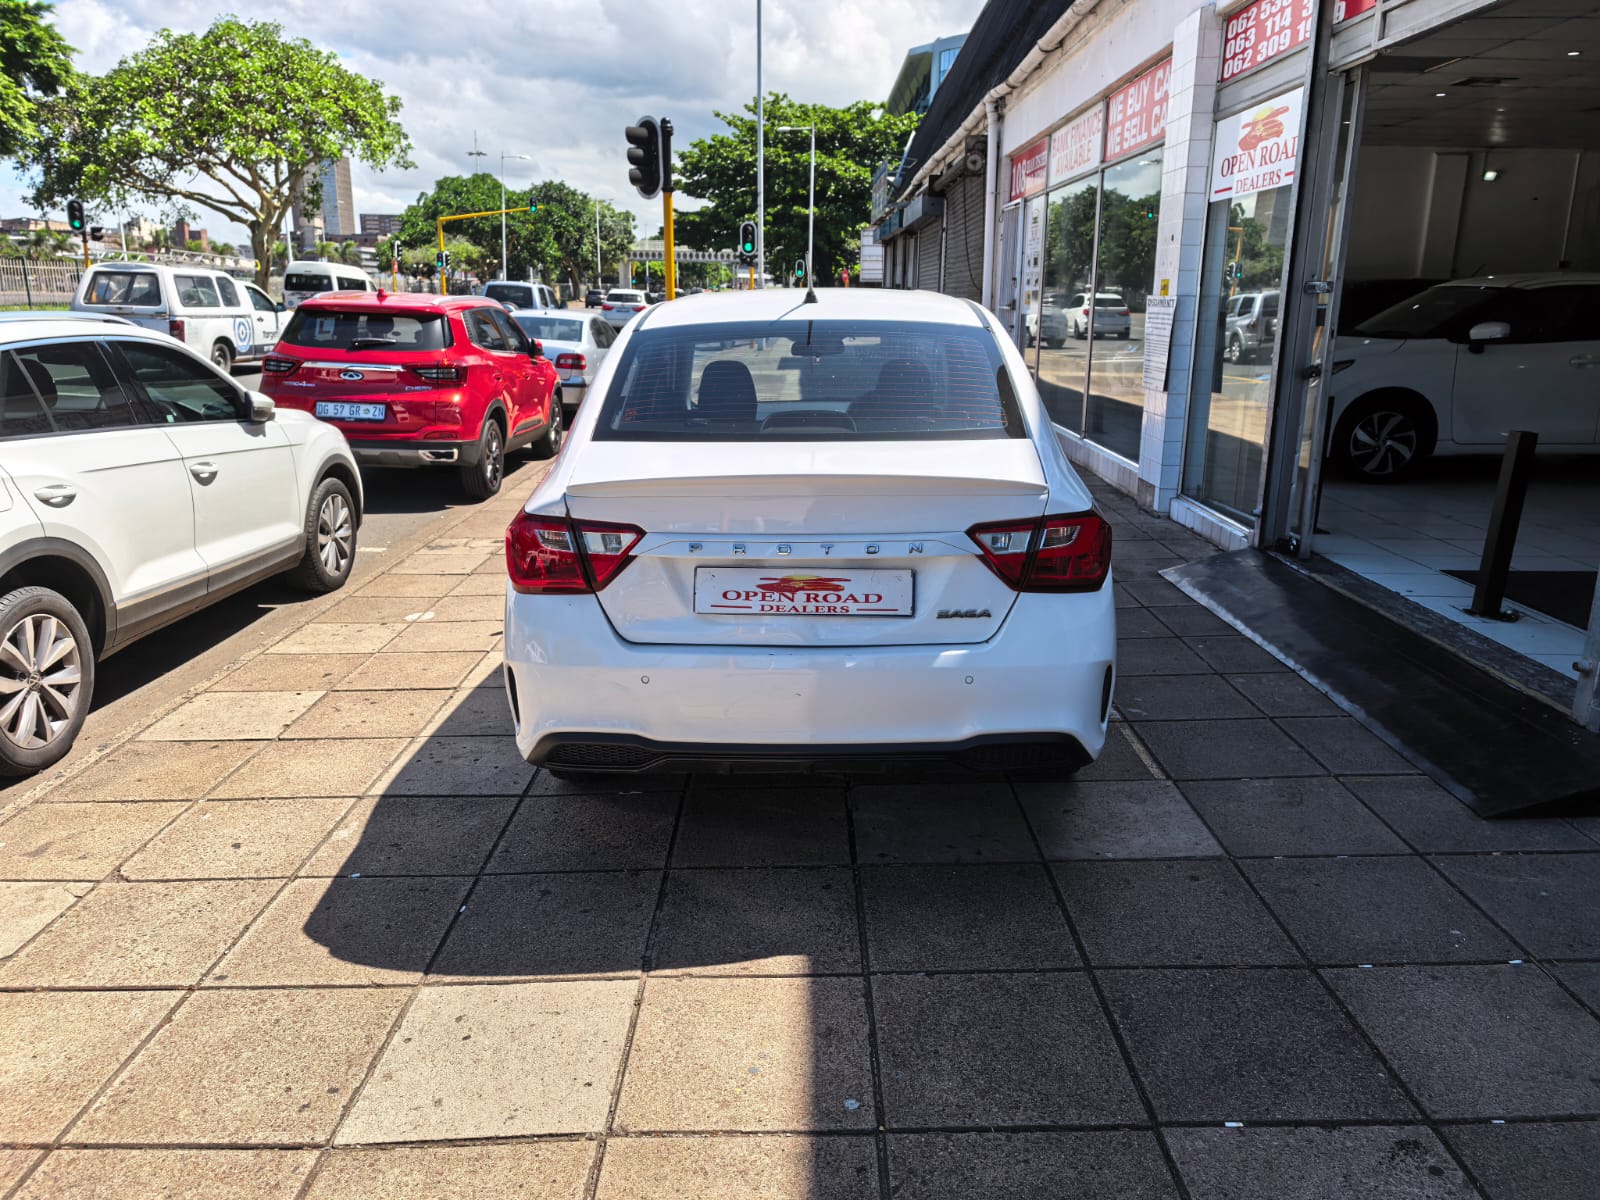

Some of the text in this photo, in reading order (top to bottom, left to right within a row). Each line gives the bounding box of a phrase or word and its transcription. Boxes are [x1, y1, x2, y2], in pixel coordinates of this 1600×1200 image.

[1225, 30, 1256, 59] 063
[1264, 6, 1292, 37] 114
[1227, 6, 1257, 39] 062
[1223, 49, 1252, 79] 062
[1256, 29, 1291, 62] 309
[1109, 94, 1124, 125] WE
[1127, 76, 1151, 116] BUY
[1051, 109, 1103, 158] BANK FINANCE
[1107, 126, 1122, 157] WE
[1123, 112, 1147, 149] SELL
[1056, 140, 1092, 176] AVAILABLE
[1221, 149, 1257, 178] OPEN
[1011, 159, 1026, 198] 108
[1235, 169, 1281, 194] DEALERS
[317, 404, 384, 417] DG 57 GR ZN
[689, 542, 923, 555] PROTON
[722, 590, 883, 604] OPEN ROAD
[760, 604, 850, 614] DEALERS
[936, 609, 992, 619] SAGA
